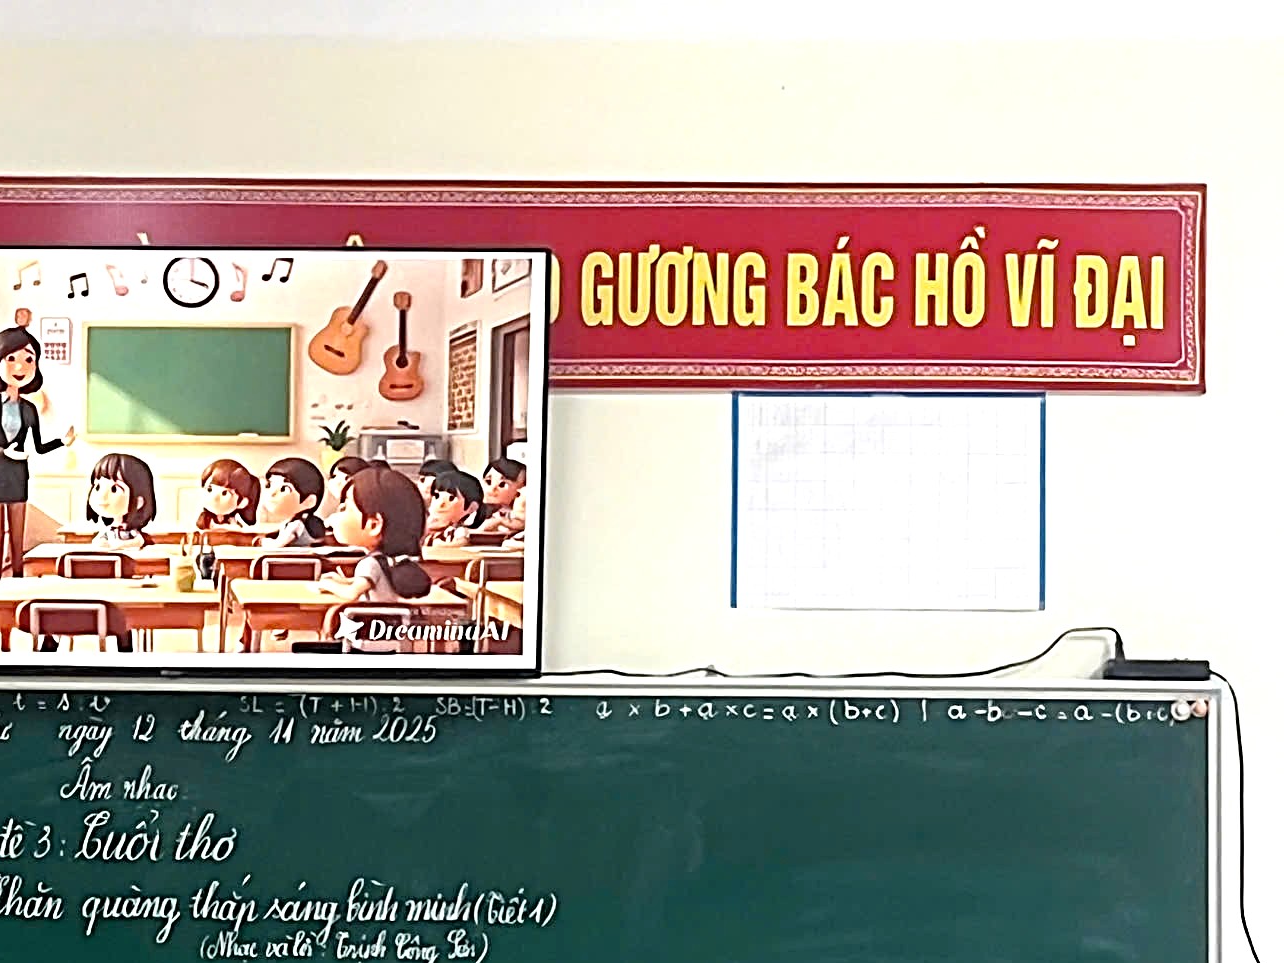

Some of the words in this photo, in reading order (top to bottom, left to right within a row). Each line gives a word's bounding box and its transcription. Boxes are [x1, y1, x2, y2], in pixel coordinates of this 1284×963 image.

[581, 243, 770, 329] GƯƠNG
[786, 235, 895, 329] BÁC
[915, 225, 988, 329] HỒ
[1004, 238, 1060, 329] VĨ
[1073, 254, 1165, 347] ĐẠI
[132, 714, 156, 742] 12
[179, 710, 253, 762] tháng
[268, 716, 295, 744] 11
[311, 718, 366, 744] năm
[372, 714, 439, 745] 2025
[59, 756, 113, 801] Âm
[74, 808, 162, 861] Tuổi
[174, 812, 237, 861] thơ
[81, 884, 181, 944] quàng
[189, 873, 259, 934] thắp
[264, 880, 342, 947] sáng
[346, 877, 398, 923] bình
[405, 882, 472, 923] minh
